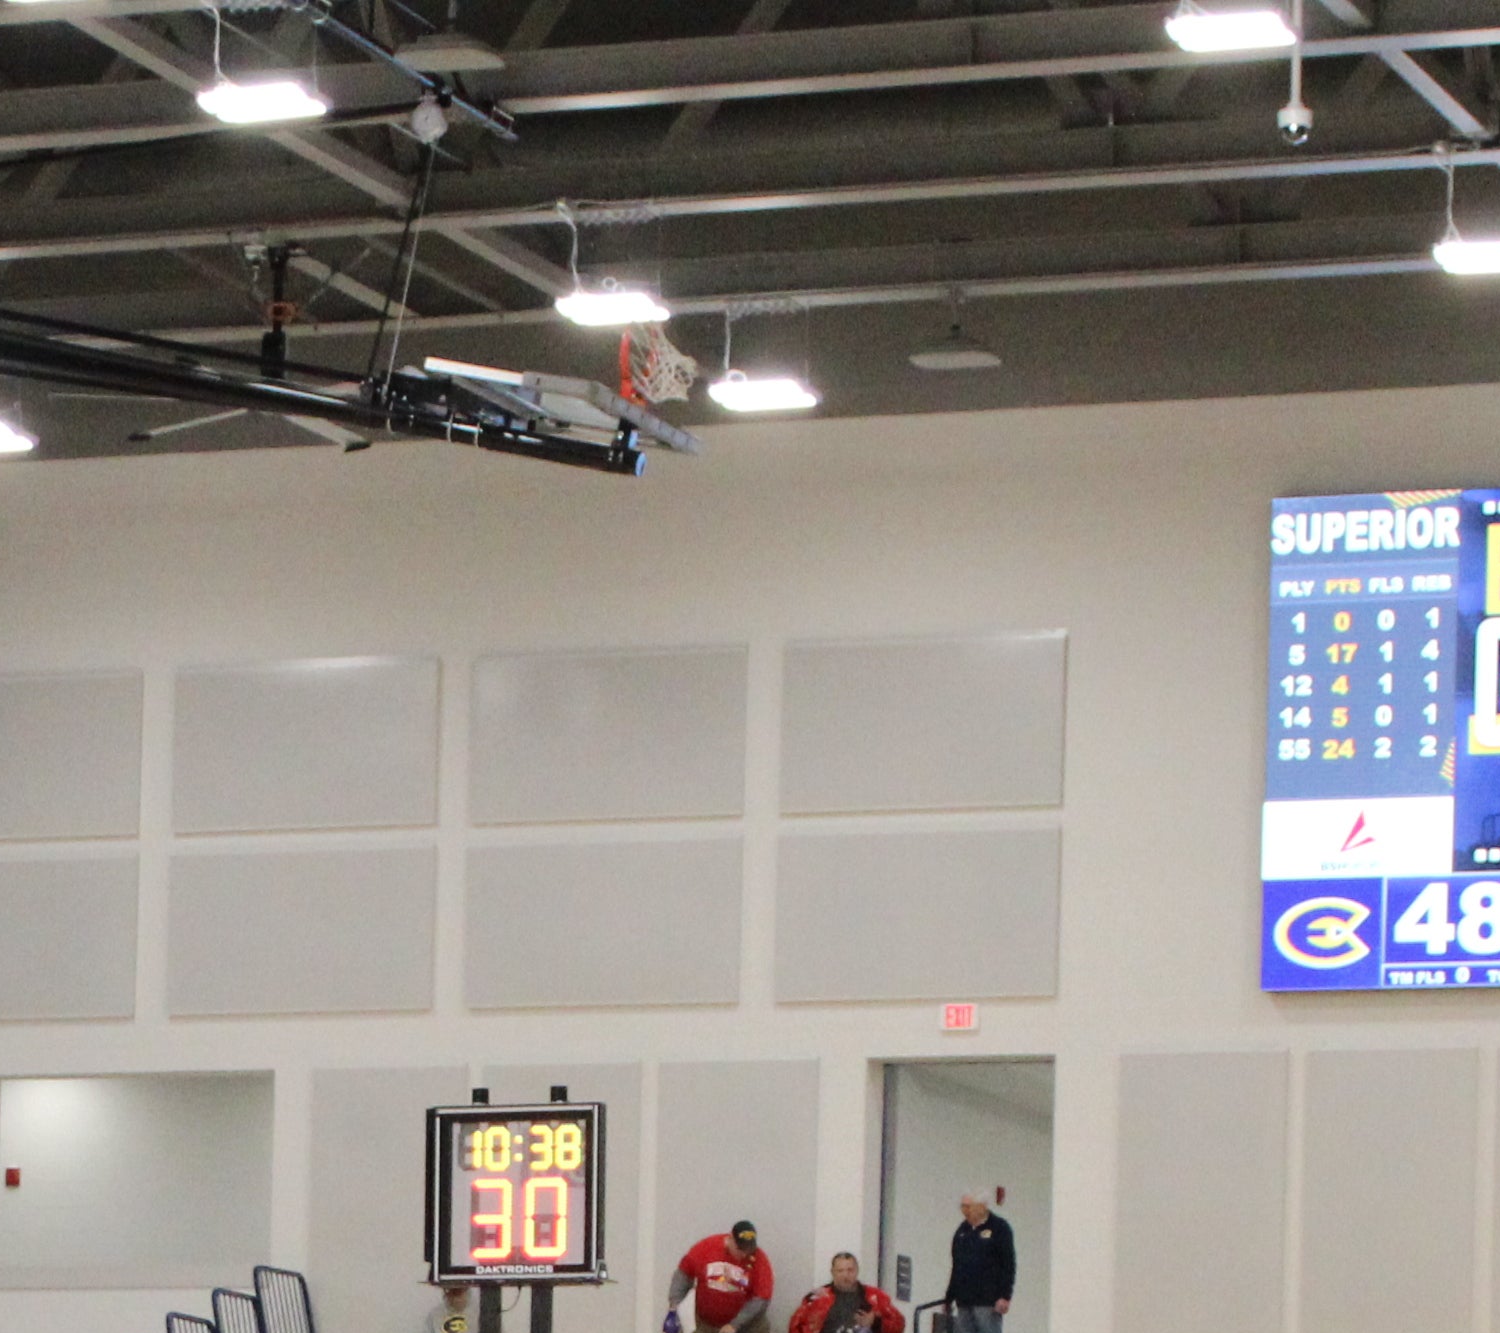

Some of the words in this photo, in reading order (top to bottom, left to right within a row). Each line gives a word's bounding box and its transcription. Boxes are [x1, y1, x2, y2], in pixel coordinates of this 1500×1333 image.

[1271, 507, 1460, 555] SUPERIOR
[1279, 580, 1314, 597] PLY
[1324, 578, 1361, 594] PTS
[1368, 577, 1404, 593] FLS
[1411, 575, 1452, 592] REB
[1291, 611, 1306, 633] 1
[1333, 611, 1351, 632] 0
[1376, 609, 1395, 631] 0
[1425, 607, 1440, 629] 1
[1288, 644, 1306, 666] 5
[1326, 643, 1358, 663] 17
[1379, 640, 1394, 662] 1
[1420, 639, 1440, 660] 4
[1279, 675, 1313, 697] 12
[1330, 674, 1349, 695] 4
[1377, 672, 1393, 694] 1
[1424, 670, 1438, 693] 1
[1278, 706, 1312, 728] 14
[1331, 706, 1349, 728] 5
[1374, 704, 1393, 727] 0
[1422, 703, 1438, 725] 1
[1278, 738, 1312, 761] 55
[1322, 738, 1356, 760] 24
[1373, 737, 1392, 759] 2
[1418, 735, 1438, 758] 2
[1454, 966, 1471, 983] 0
[470, 1124, 582, 1172] 10:38
[470, 1176, 568, 1262] 30
[475, 1264, 554, 1275] DAKTRONICS
